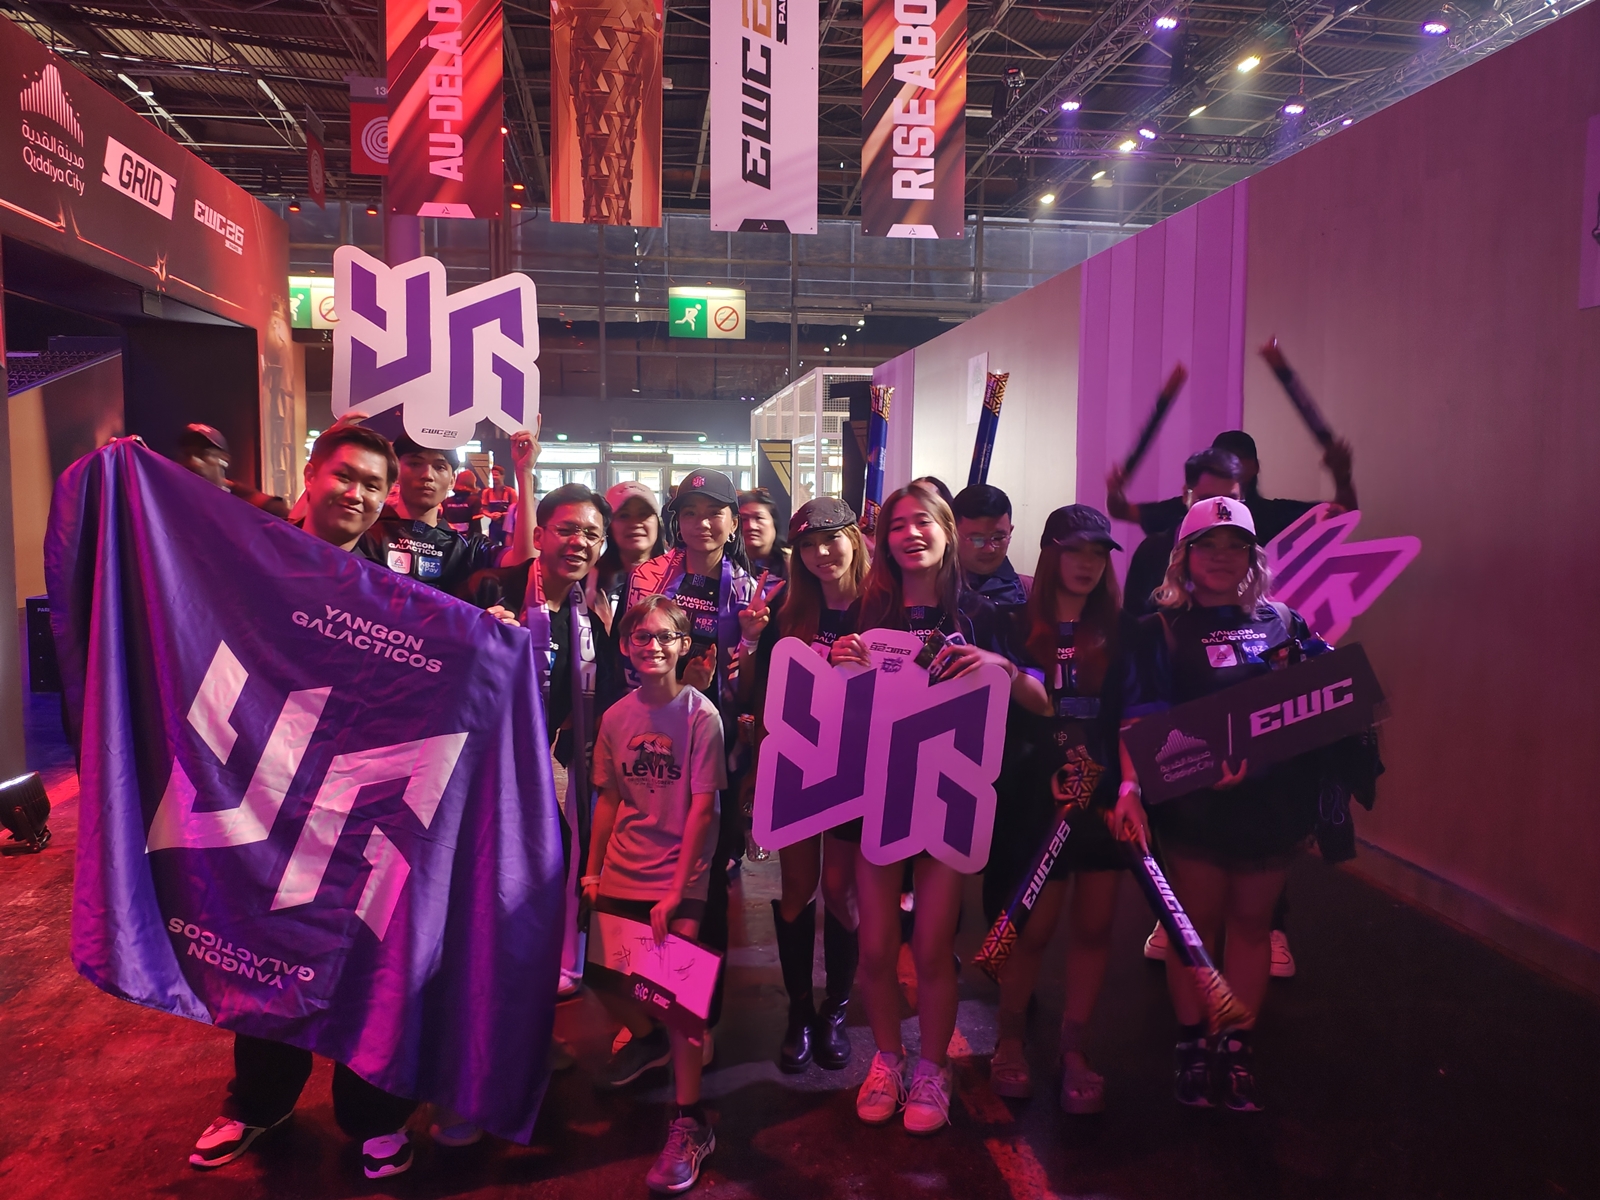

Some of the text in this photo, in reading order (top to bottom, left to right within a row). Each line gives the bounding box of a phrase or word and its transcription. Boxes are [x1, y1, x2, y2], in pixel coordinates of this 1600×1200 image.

[778, 0, 787, 25] PA
[420, 30, 463, 182] AU-DELÀ
[22, 146, 85, 197] Qiddiya City
[892, 98, 936, 200] RISE
[119, 152, 163, 208] GRID
[388, 541, 443, 557] GALACTICOS
[398, 538, 435, 550] YANGON
[675, 593, 714, 606] YANGON
[695, 617, 713, 626] KBZ
[291, 610, 443, 673] GALACTICOS
[325, 604, 424, 651] YANGON
[1201, 633, 1267, 644] GALACTICOS
[1209, 628, 1254, 638] YANGON
[1250, 677, 1354, 738] EWC
[167, 917, 315, 982] GALACTICOS
[186, 941, 284, 990] YANGON
